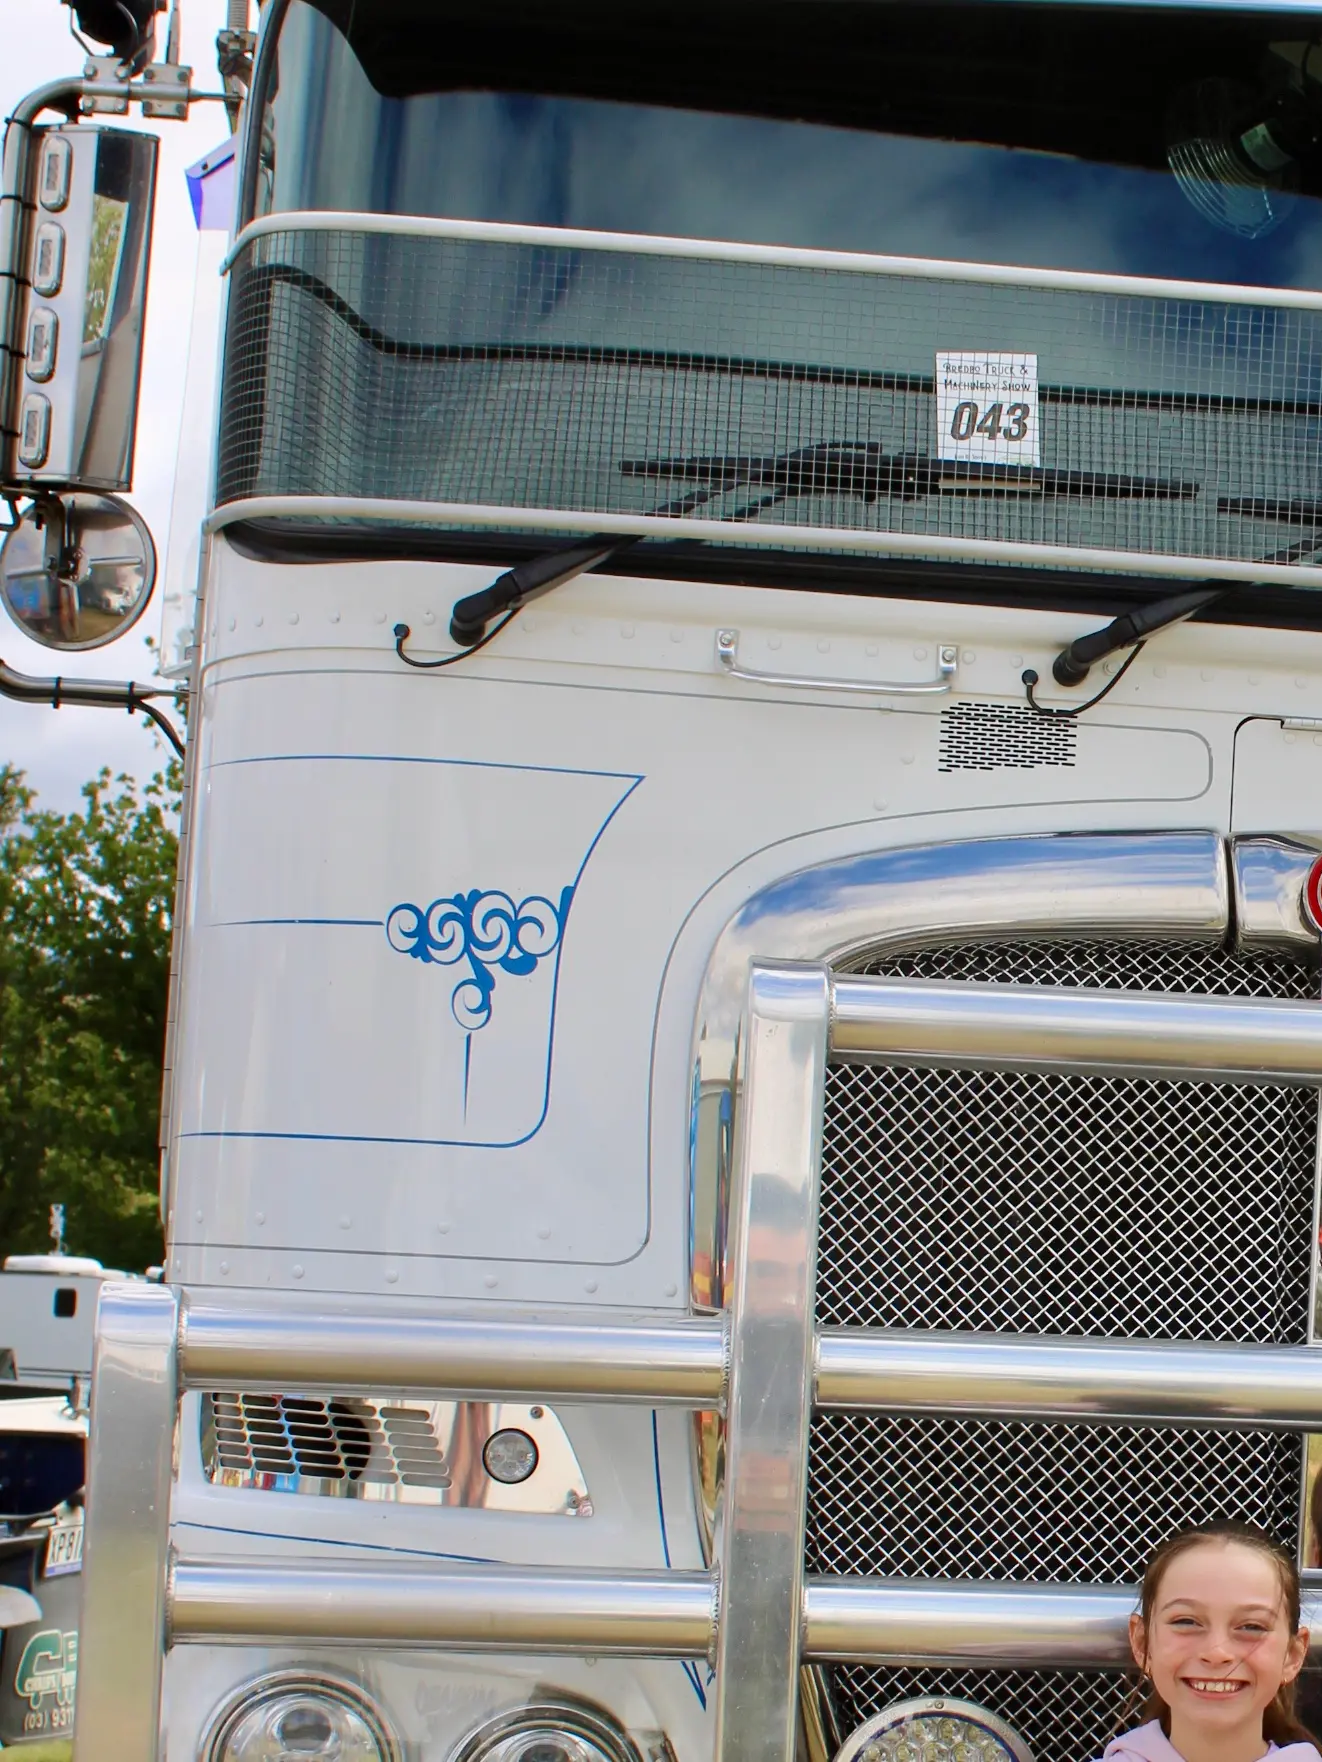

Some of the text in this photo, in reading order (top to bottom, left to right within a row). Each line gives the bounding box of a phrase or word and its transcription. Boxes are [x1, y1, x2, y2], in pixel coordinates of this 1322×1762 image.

[983, 362, 1016, 376] TRUCK
[1020, 364, 1028, 375] &
[944, 379, 1031, 392] MACHINERY SHOW
[951, 401, 1030, 442] 043
